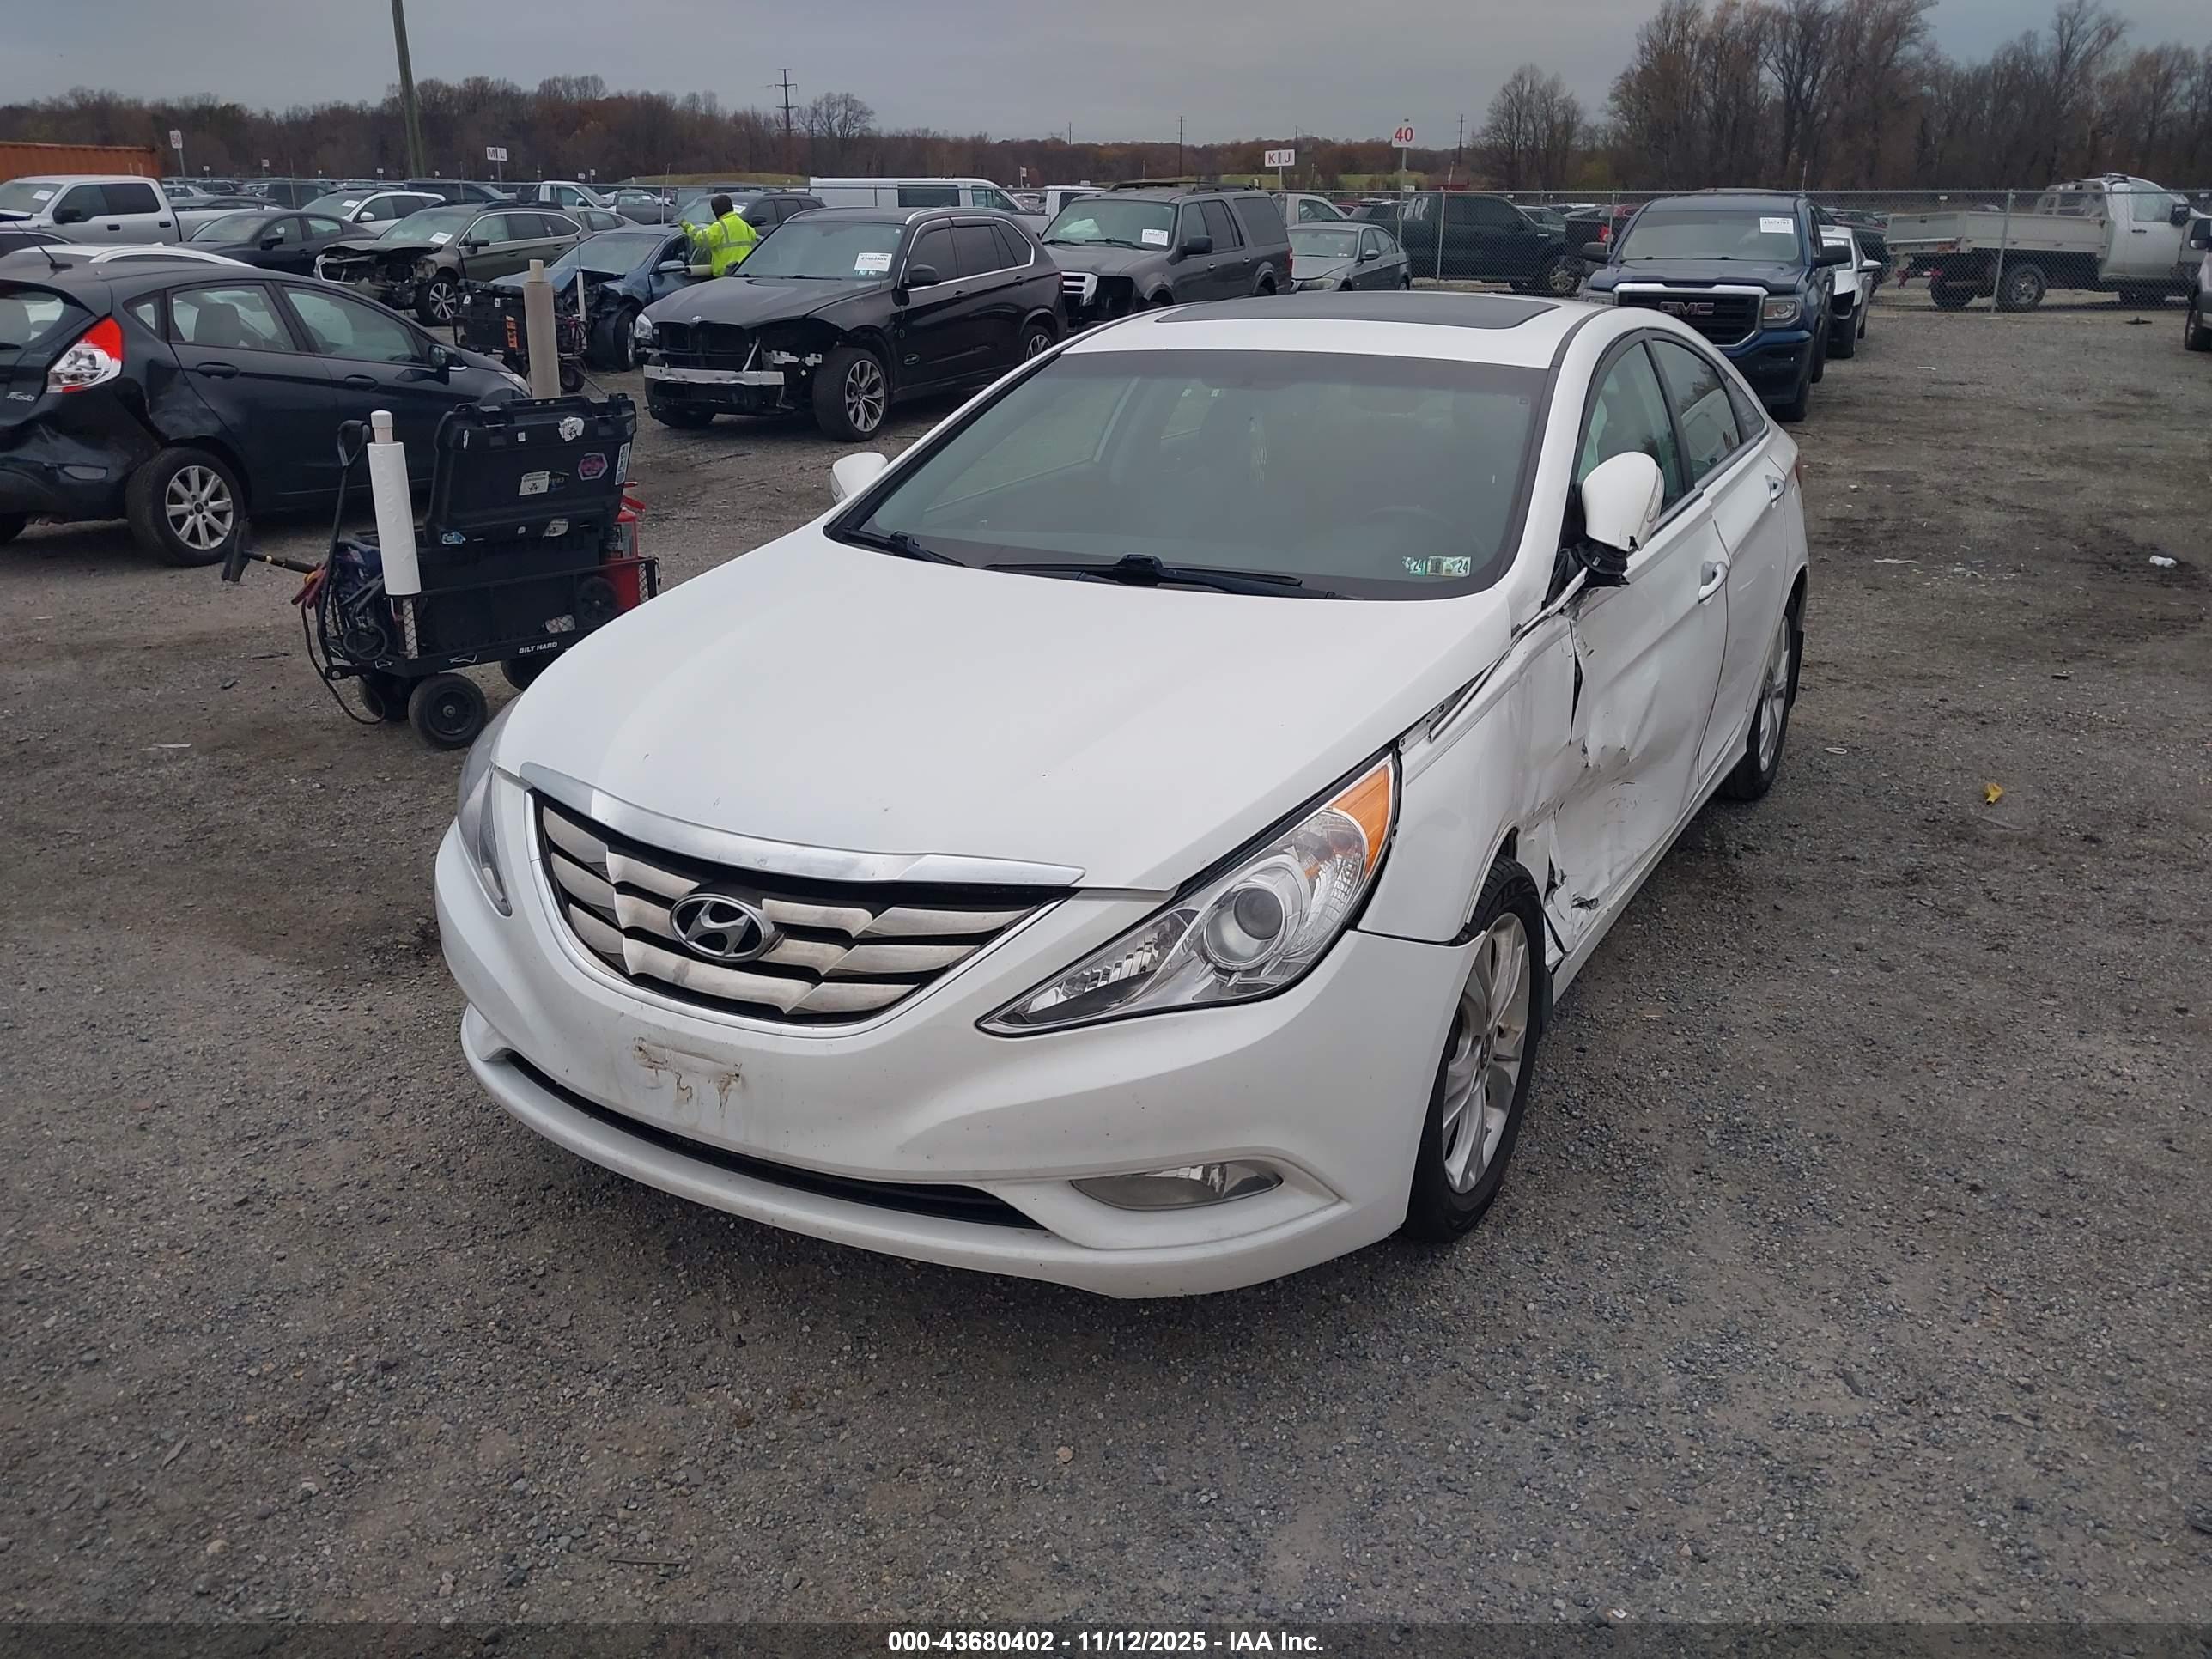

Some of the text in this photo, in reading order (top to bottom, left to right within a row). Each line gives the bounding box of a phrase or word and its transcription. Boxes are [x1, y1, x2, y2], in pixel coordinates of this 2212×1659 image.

[1394, 126, 1414, 143] 40
[1659, 301, 1715, 316] GMC
[536, 641, 558, 651] HARD
